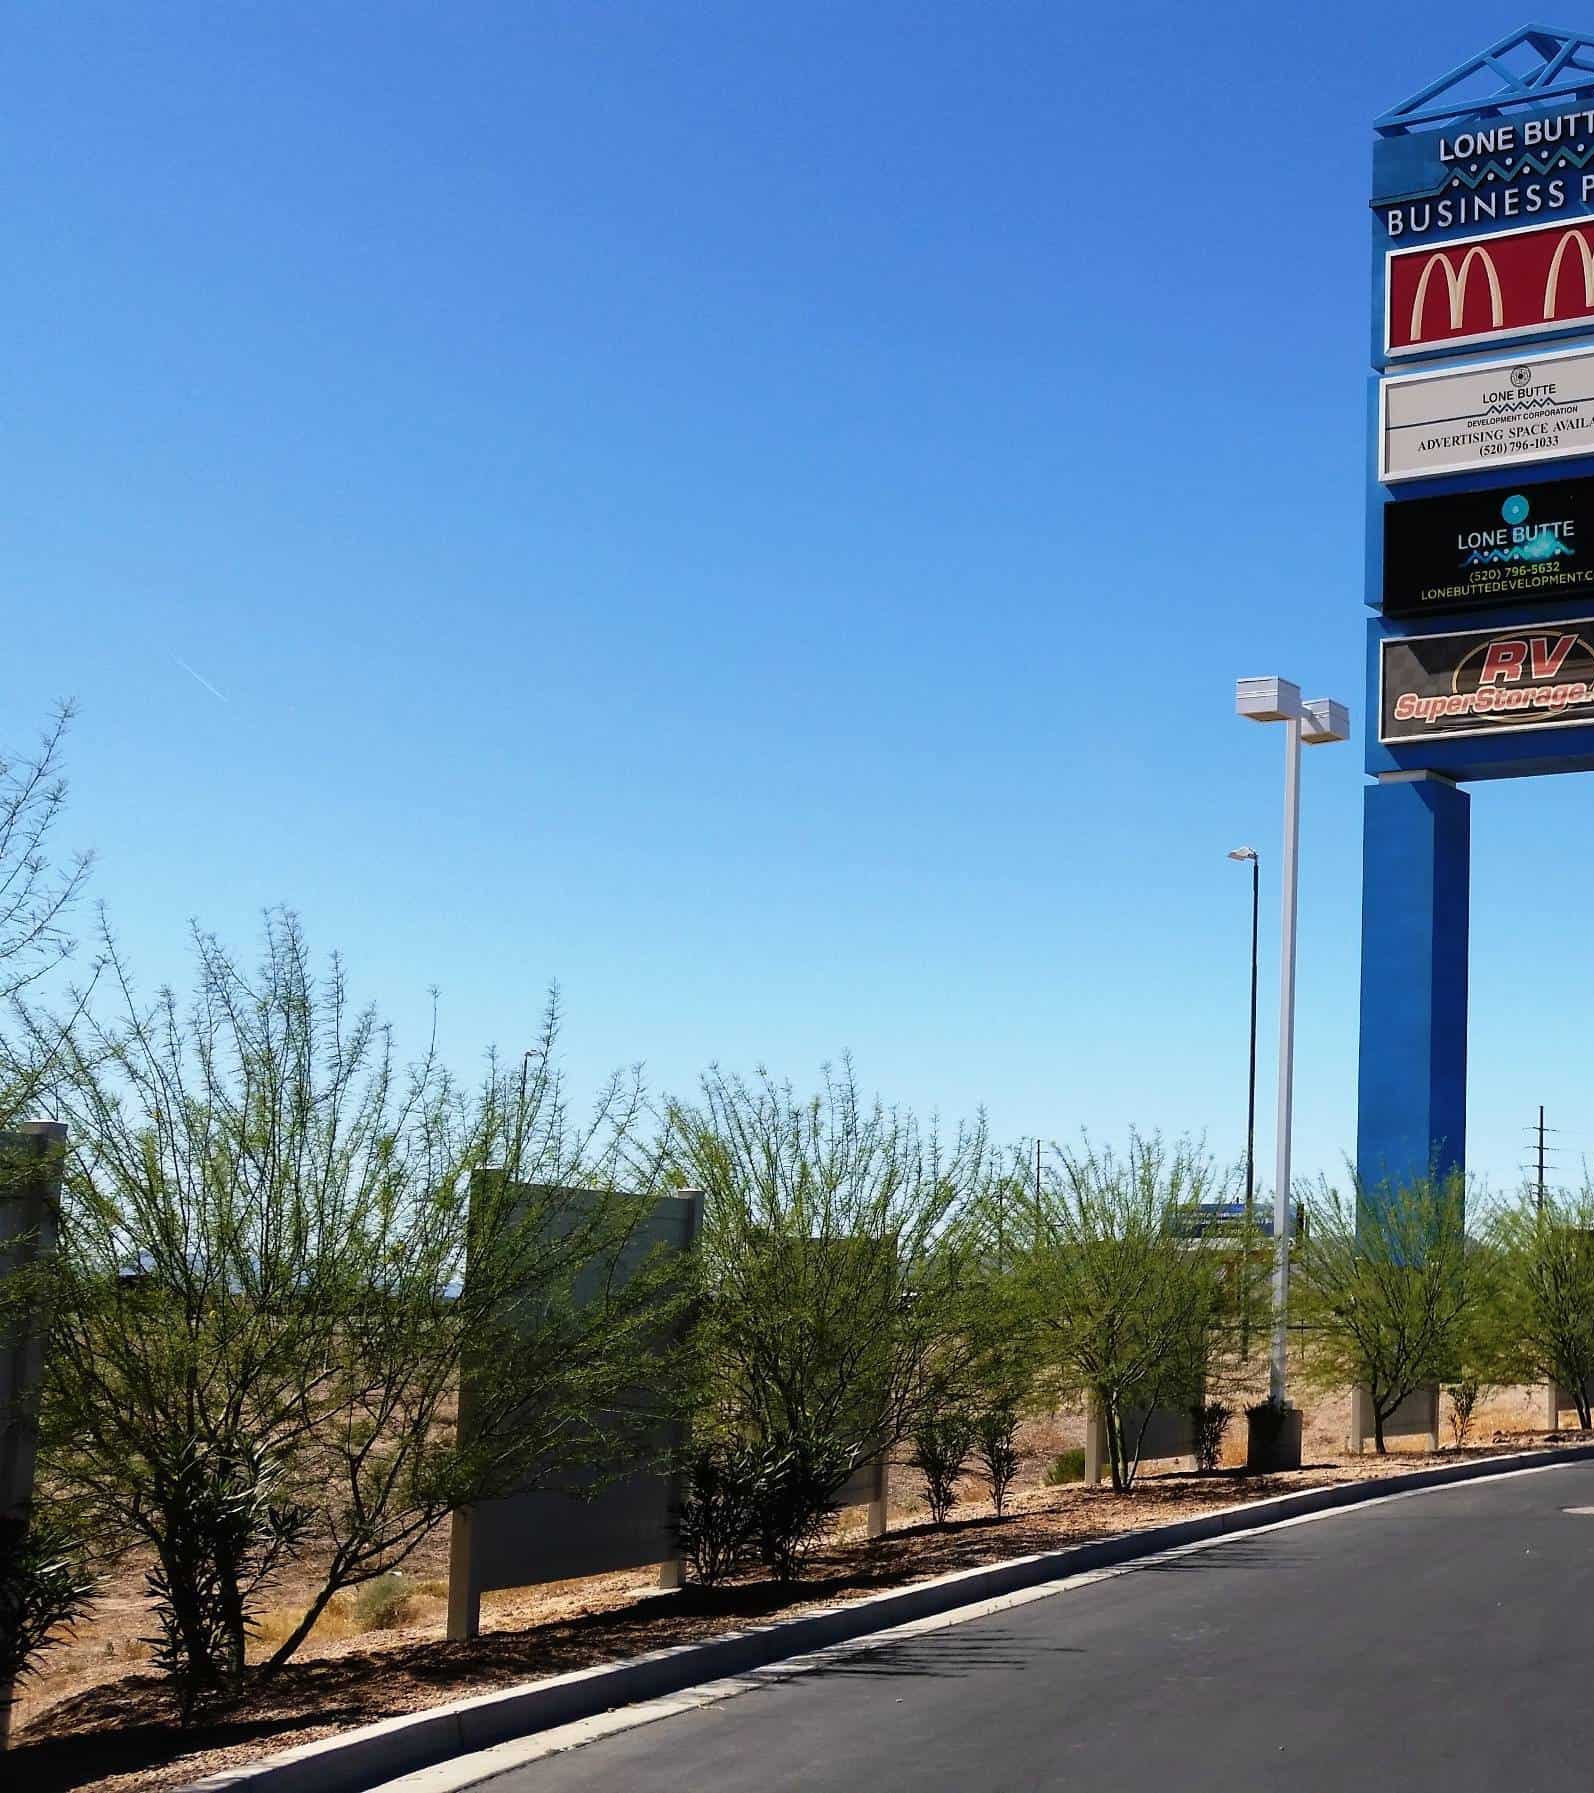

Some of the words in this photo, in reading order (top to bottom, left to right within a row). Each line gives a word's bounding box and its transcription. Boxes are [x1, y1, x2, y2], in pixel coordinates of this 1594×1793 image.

[1439, 125, 1514, 162] LONE
[1387, 180, 1565, 236] BUSINESS
[1482, 390, 1514, 404] LONE
[1517, 384, 1557, 400] BUTTE
[1467, 414, 1522, 428] DEVELOPMENT
[1522, 406, 1578, 420] CORPORATION
[1418, 429, 1504, 452] ADVERTISING
[1508, 422, 1549, 439] SPACE
[1479, 441, 1507, 457] (520)
[1509, 435, 1559, 452] 796-1033
[1458, 528, 1508, 550] LONE
[1512, 520, 1575, 544] BUTTE
[1469, 568, 1501, 583] (520)
[1478, 633, 1579, 685] RV
